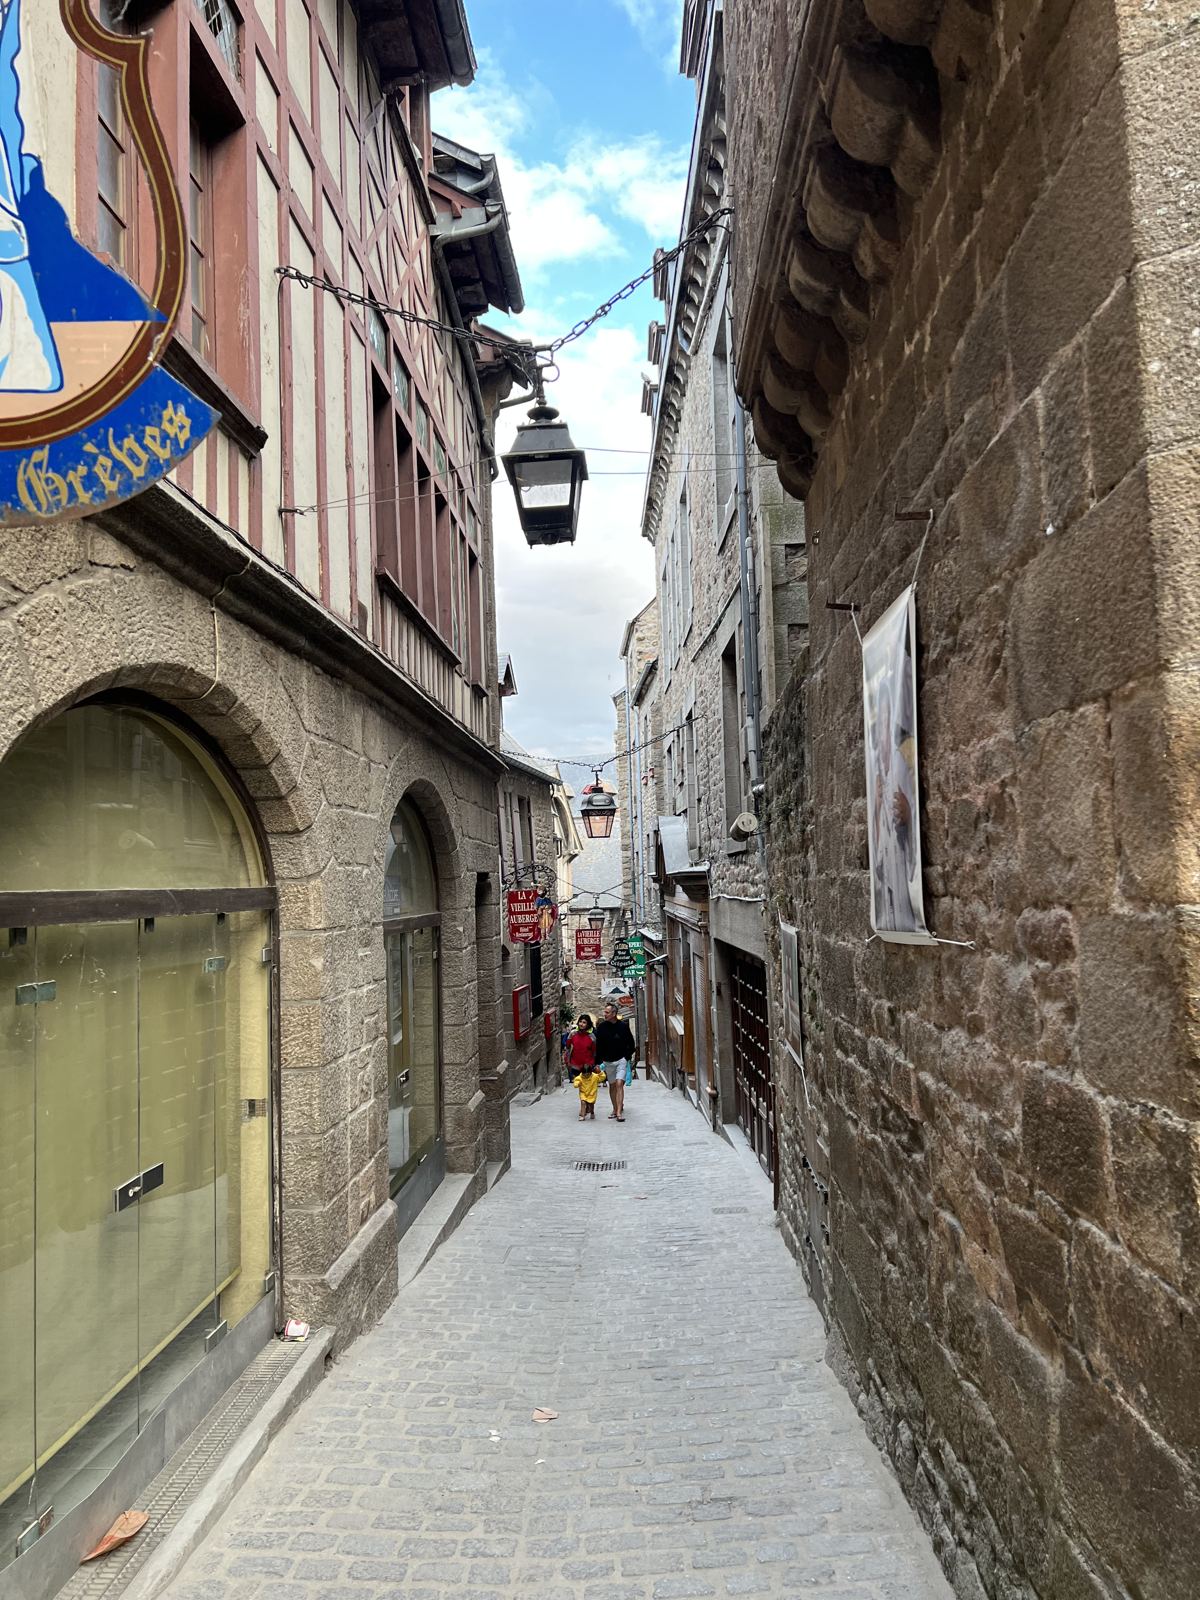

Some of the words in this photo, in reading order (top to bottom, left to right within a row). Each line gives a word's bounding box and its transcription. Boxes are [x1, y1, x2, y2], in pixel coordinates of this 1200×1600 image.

[16, 400, 192, 518] Grèbes
[518, 891, 526, 900] LA
[510, 902, 535, 911] VIEILLE
[510, 914, 538, 923] AUBERGE
